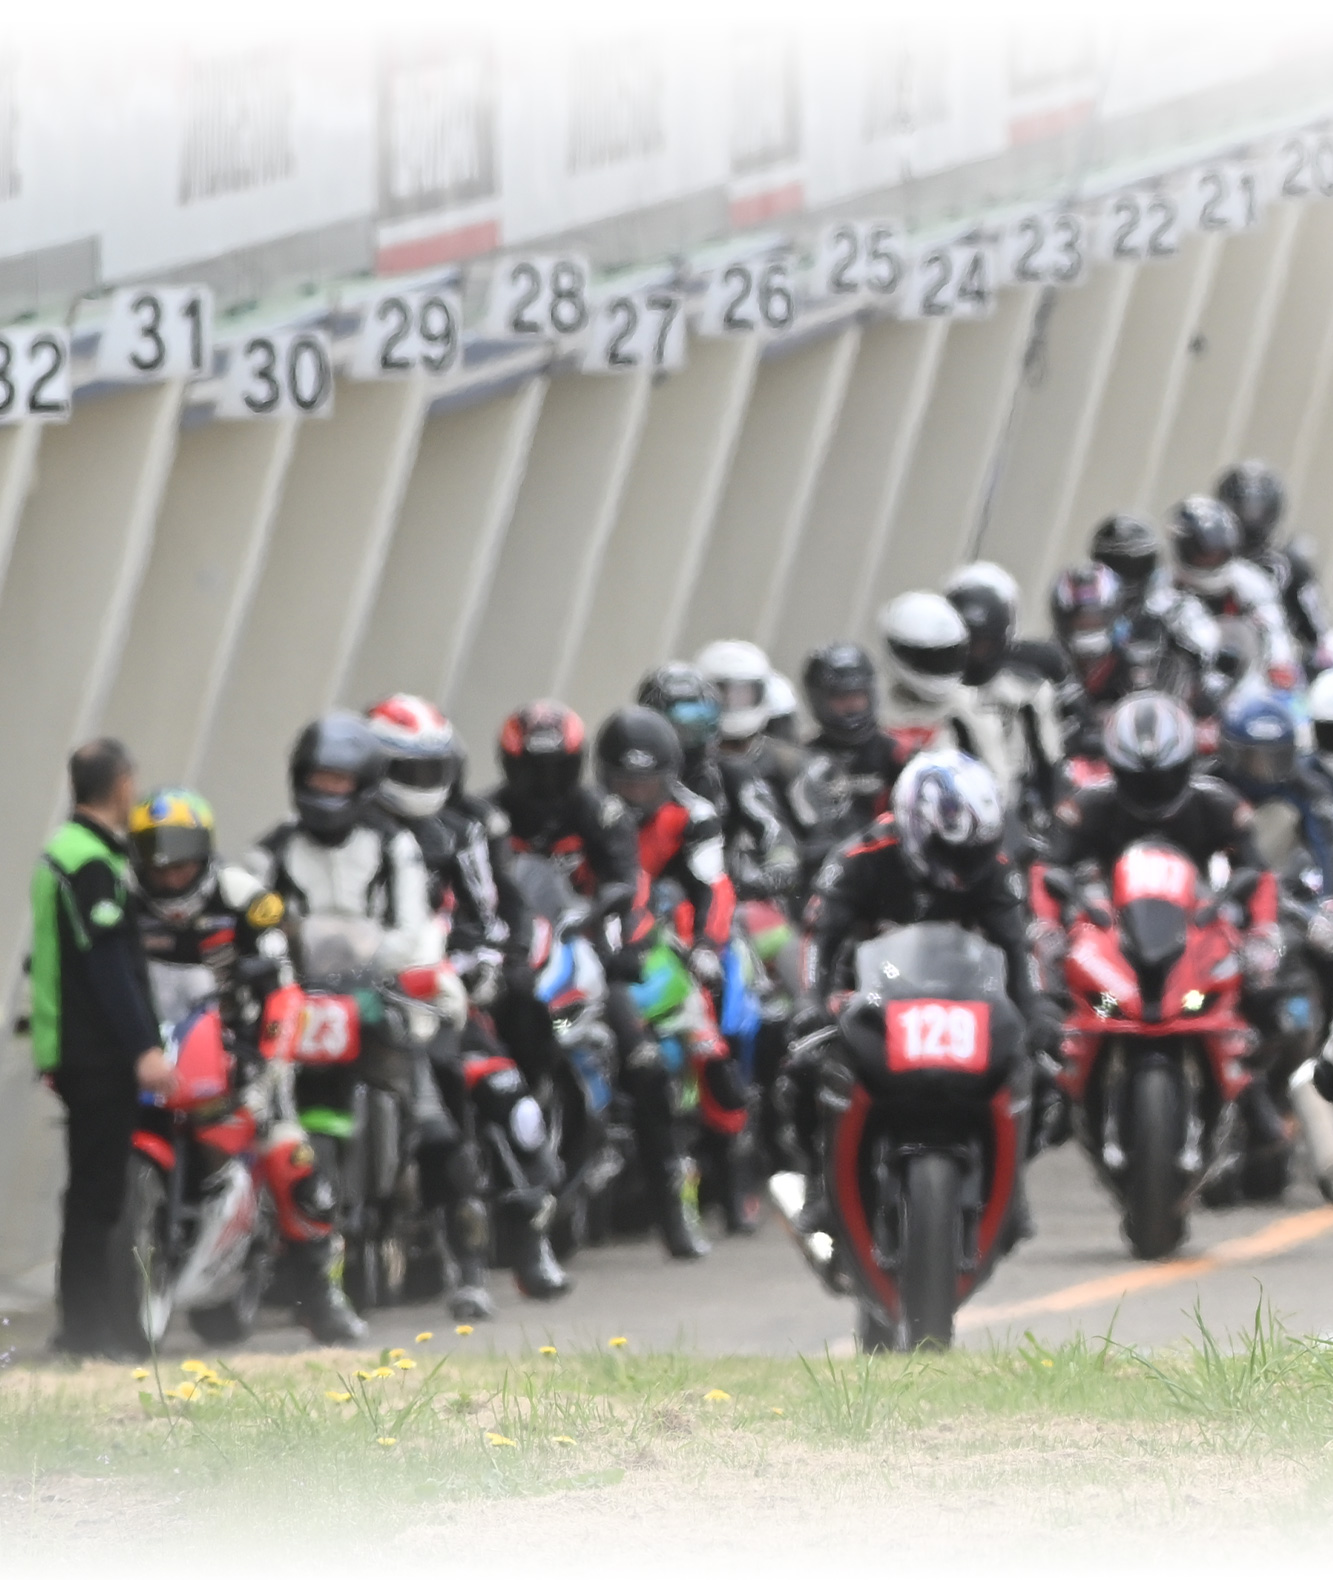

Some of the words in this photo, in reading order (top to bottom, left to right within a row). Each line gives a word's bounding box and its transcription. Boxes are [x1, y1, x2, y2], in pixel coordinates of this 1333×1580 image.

[1113, 200, 1179, 259] 22
[1201, 174, 1258, 230] 21
[829, 225, 902, 296] 25
[923, 252, 989, 316] 24
[1017, 216, 1084, 284] 23
[128, 292, 203, 372] 31
[510, 261, 588, 336] 28
[605, 295, 683, 368] 27
[723, 266, 796, 334] 26
[377, 295, 459, 374] 29
[243, 336, 331, 413] 30
[900, 1008, 978, 1059] 129
